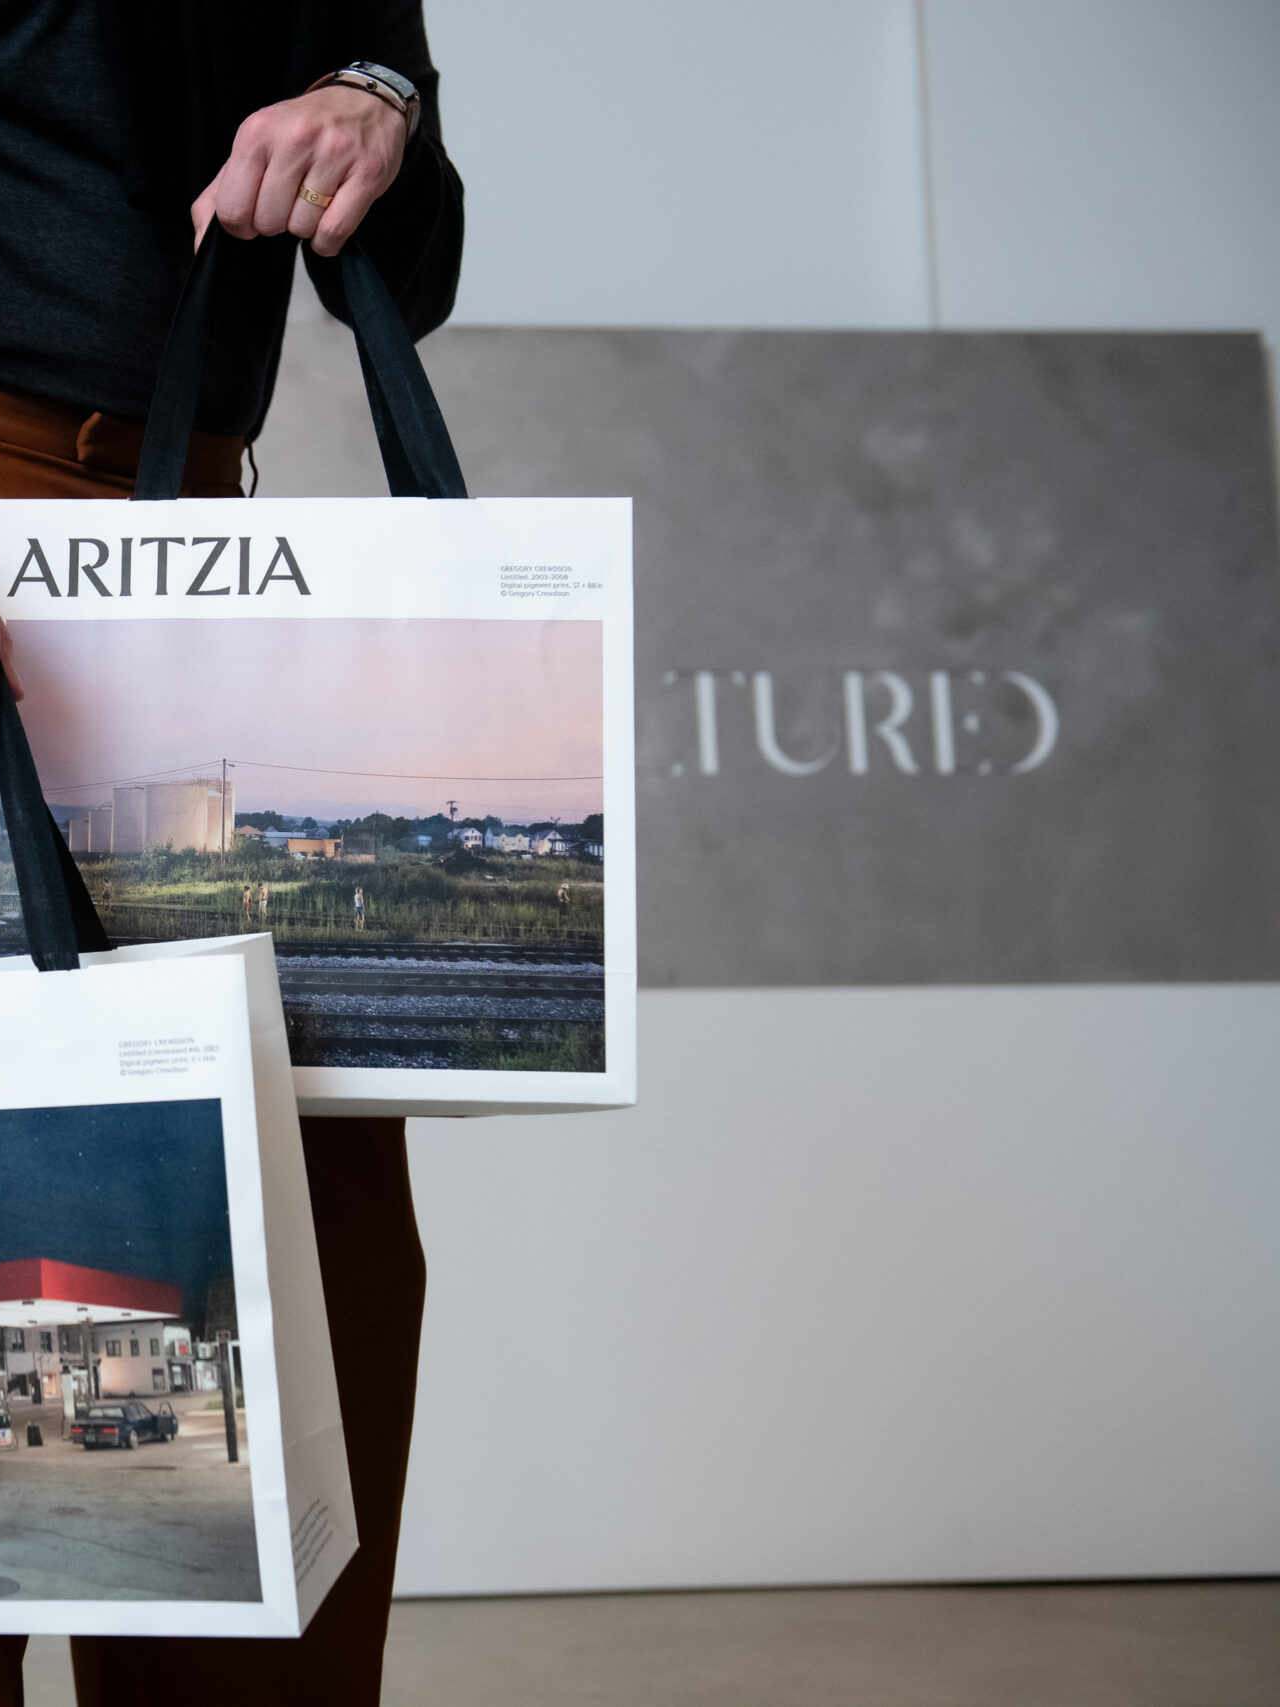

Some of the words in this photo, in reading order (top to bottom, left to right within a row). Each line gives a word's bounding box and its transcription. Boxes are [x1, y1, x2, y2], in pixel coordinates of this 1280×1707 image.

[7, 537, 311, 597] ARITZIA
[500, 581, 522, 589] Digital
[508, 590, 535, 598] Gregory
[661, 669, 1061, 777] TURED
